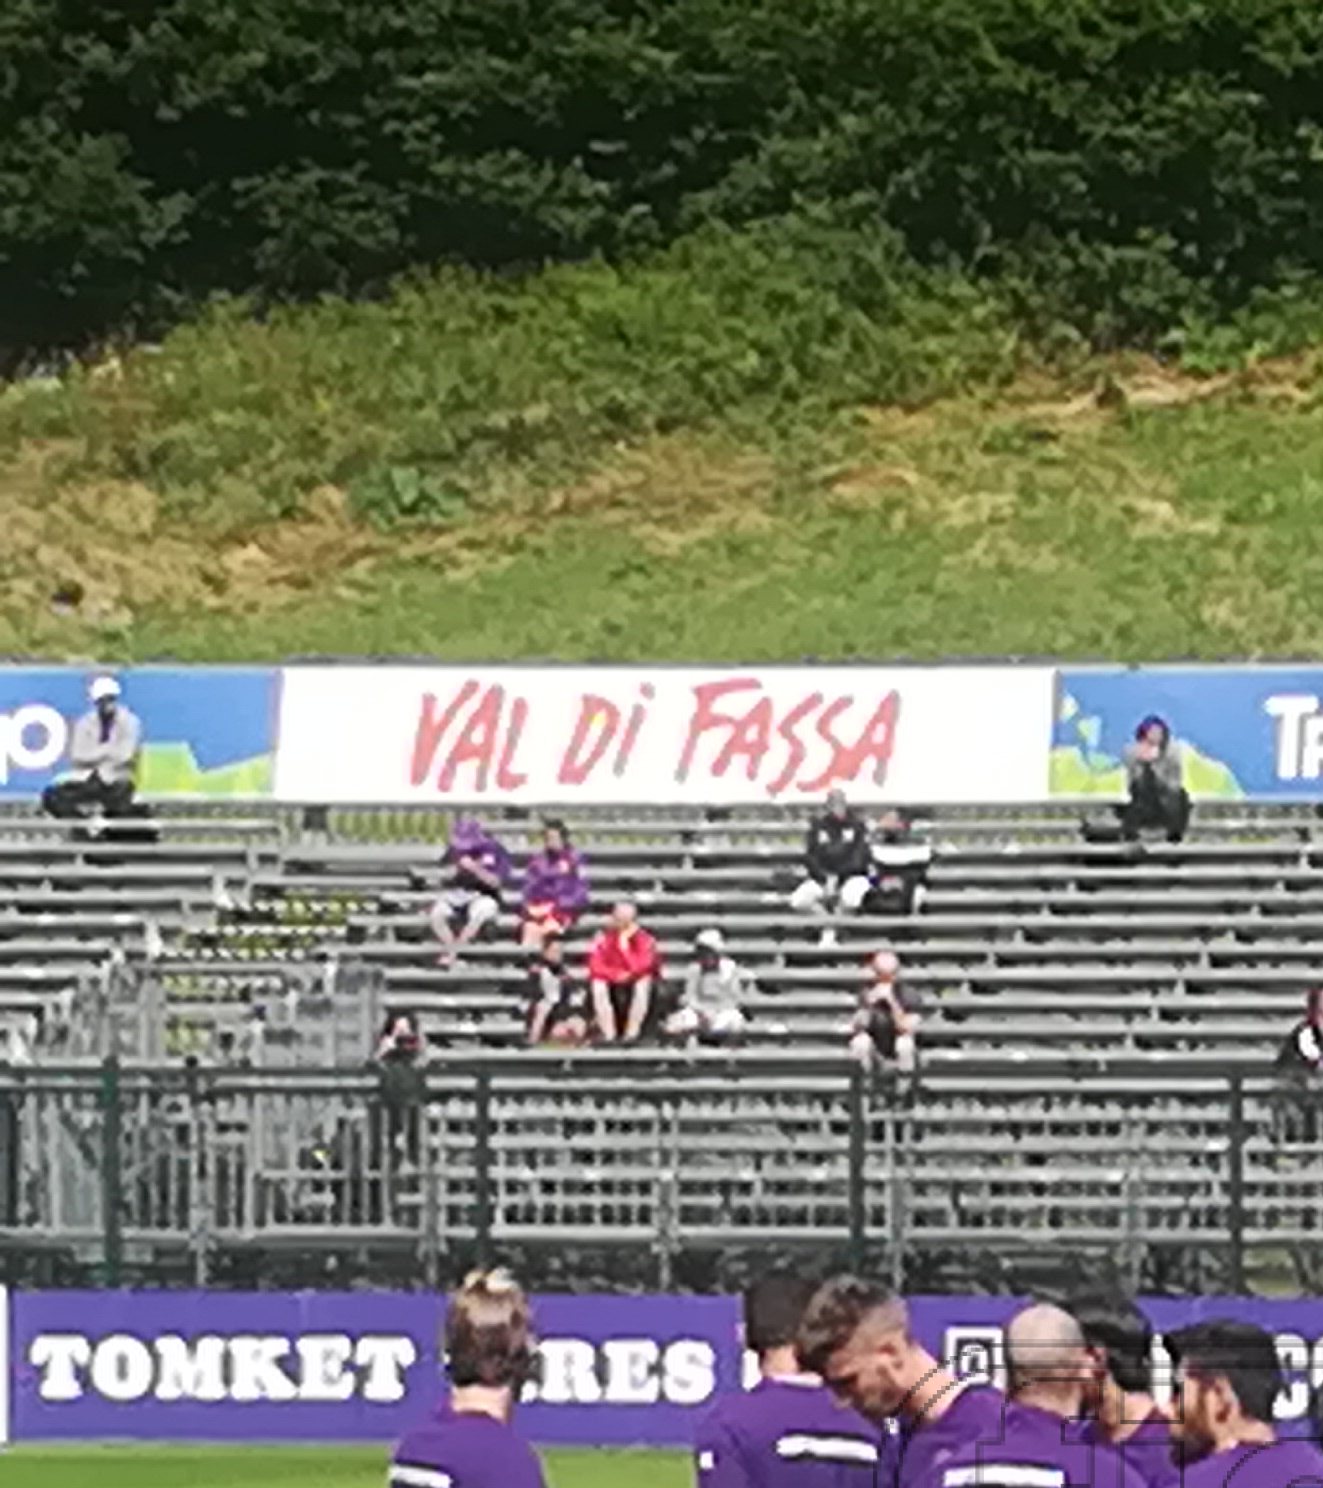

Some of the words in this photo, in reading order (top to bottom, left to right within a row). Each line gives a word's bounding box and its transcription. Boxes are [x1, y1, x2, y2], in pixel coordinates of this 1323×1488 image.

[409, 679, 528, 792] VAL
[675, 676, 901, 797] FASSA
[29, 1334, 416, 1402] TOMKET
